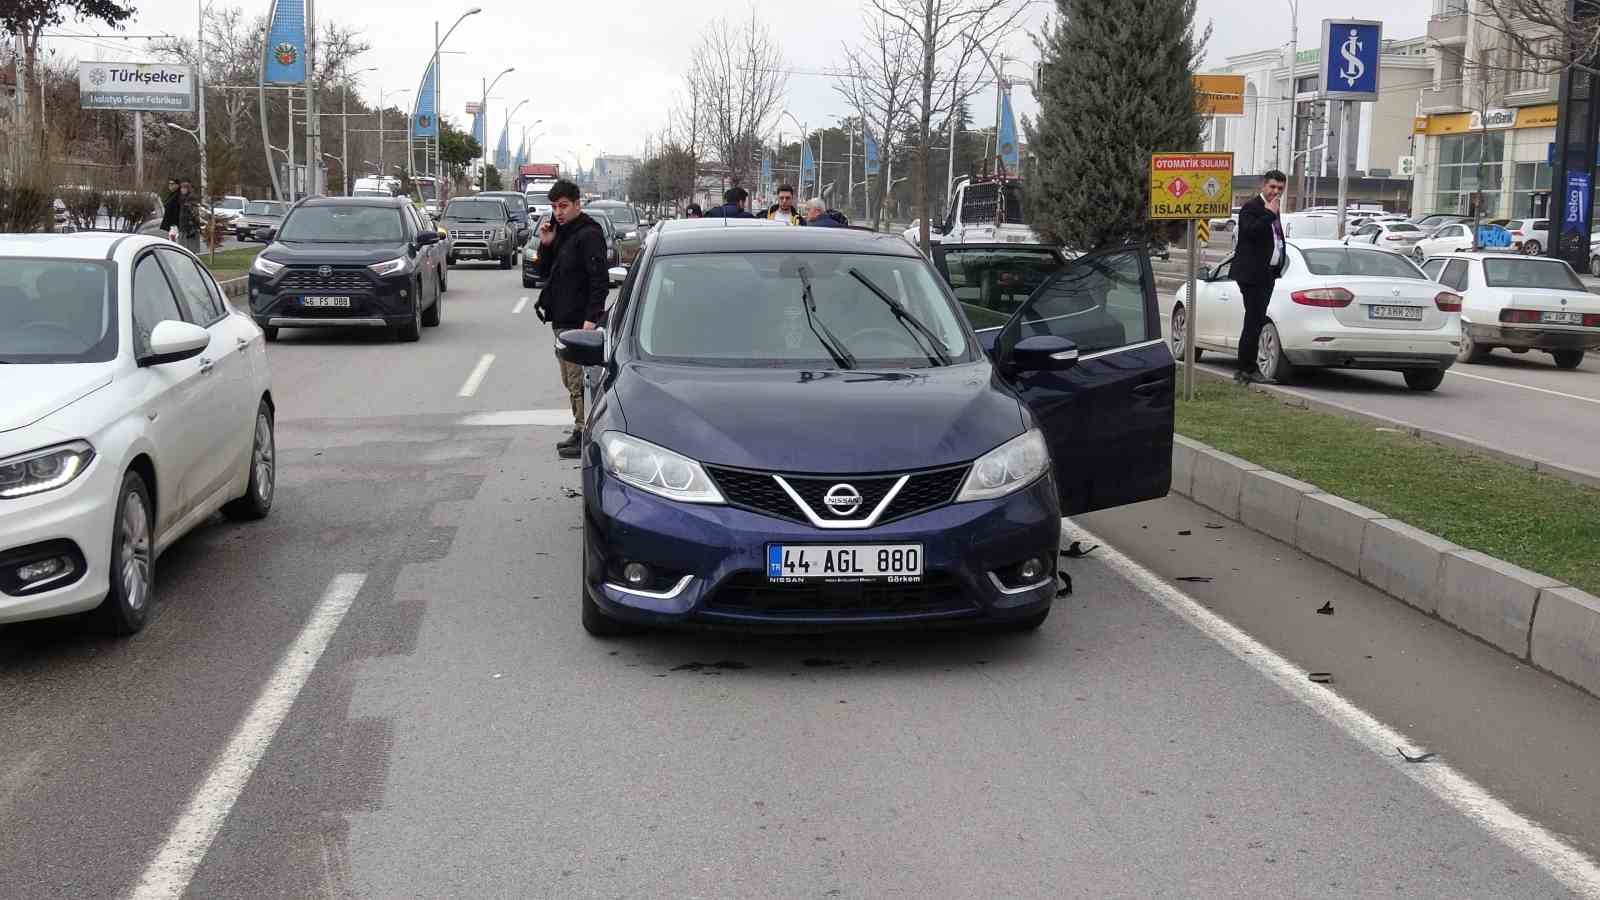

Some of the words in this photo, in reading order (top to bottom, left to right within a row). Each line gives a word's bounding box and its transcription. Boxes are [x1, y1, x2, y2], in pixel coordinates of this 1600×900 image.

[109, 69, 185, 85] Türkşeker
[1156, 158, 1199, 169] OTOMATİK
[1200, 159, 1229, 169] SULAMA
[1154, 203, 1191, 215] ISLAK
[319, 297, 329, 306] FS
[783, 550, 810, 573] 44
[823, 549, 864, 573] AGL
[877, 549, 918, 572] 880
[887, 575, 921, 583] Görkem
